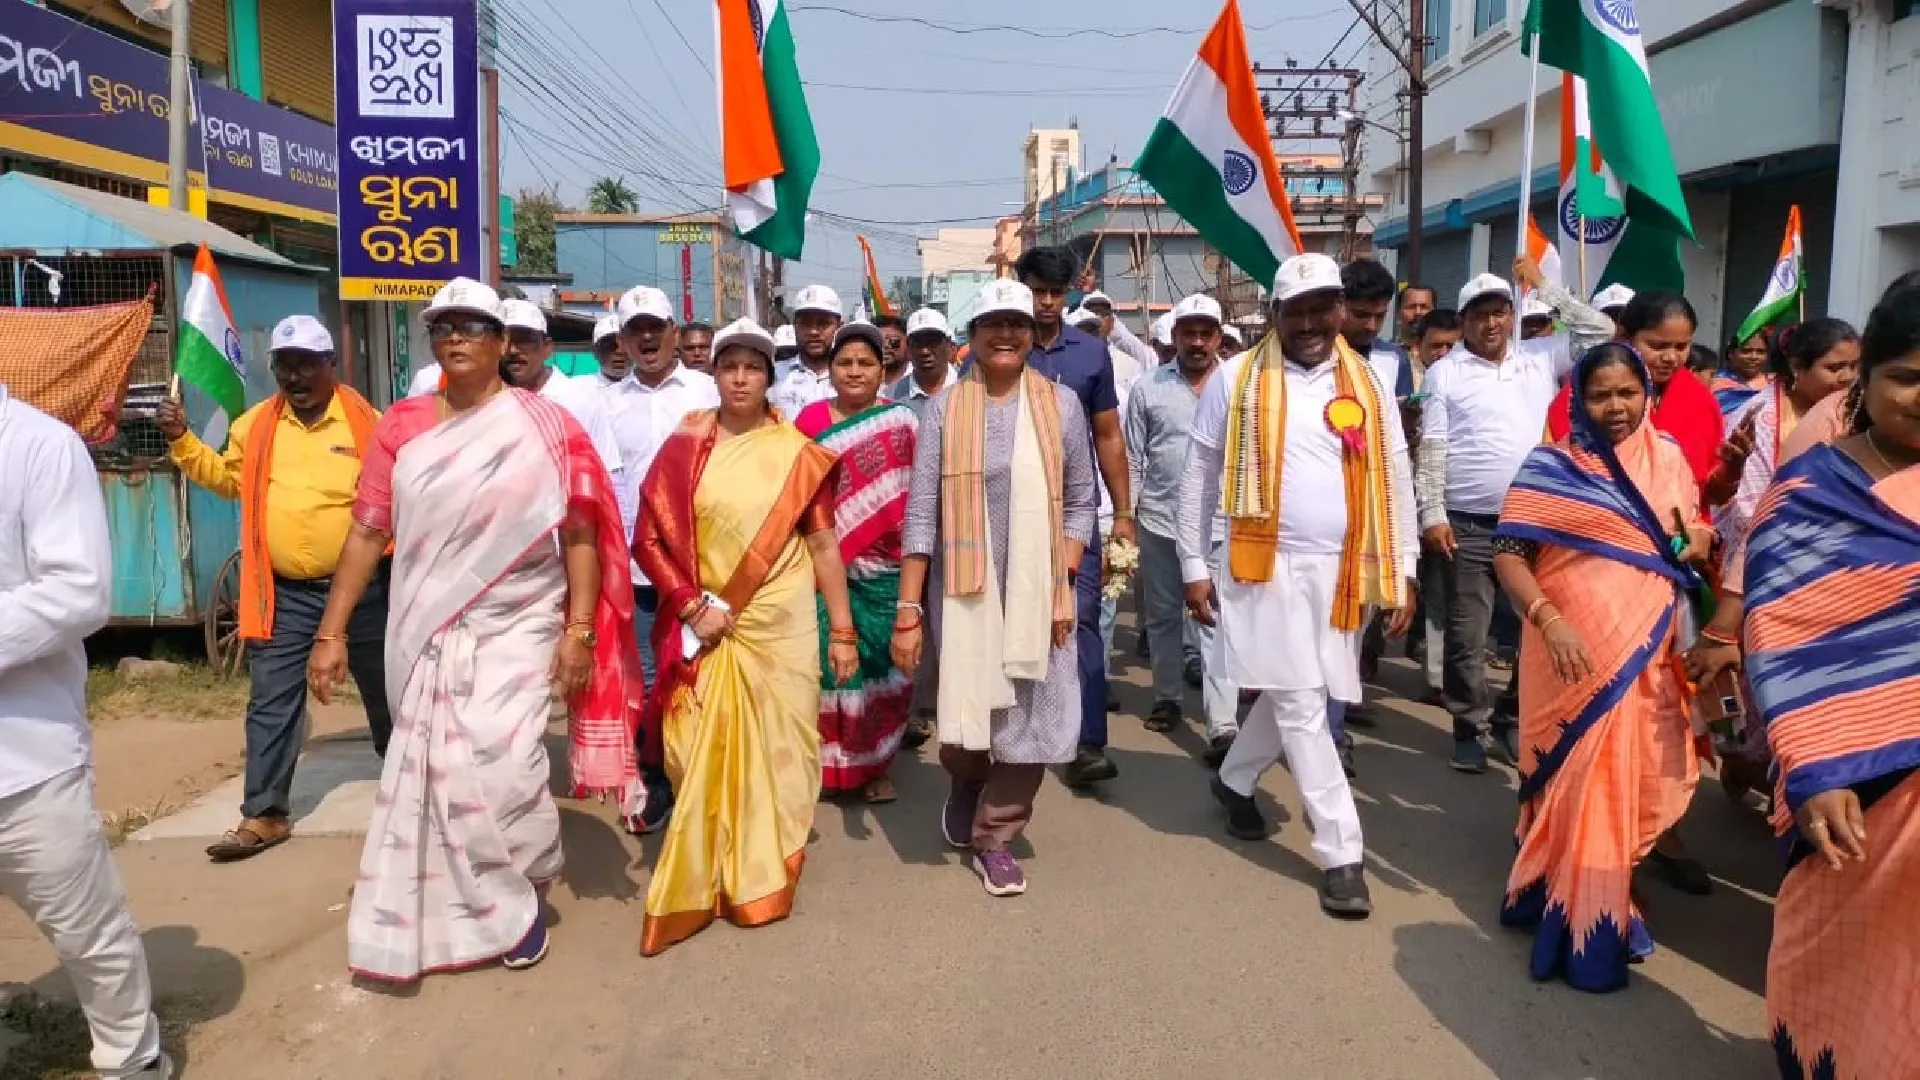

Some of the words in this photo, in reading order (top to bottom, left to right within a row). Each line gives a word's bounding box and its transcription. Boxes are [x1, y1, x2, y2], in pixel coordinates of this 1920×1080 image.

[359, 174, 458, 222] ସୁନା
[360, 225, 460, 266] ଋଣ
[373, 284, 445, 296] NIMAPAD
